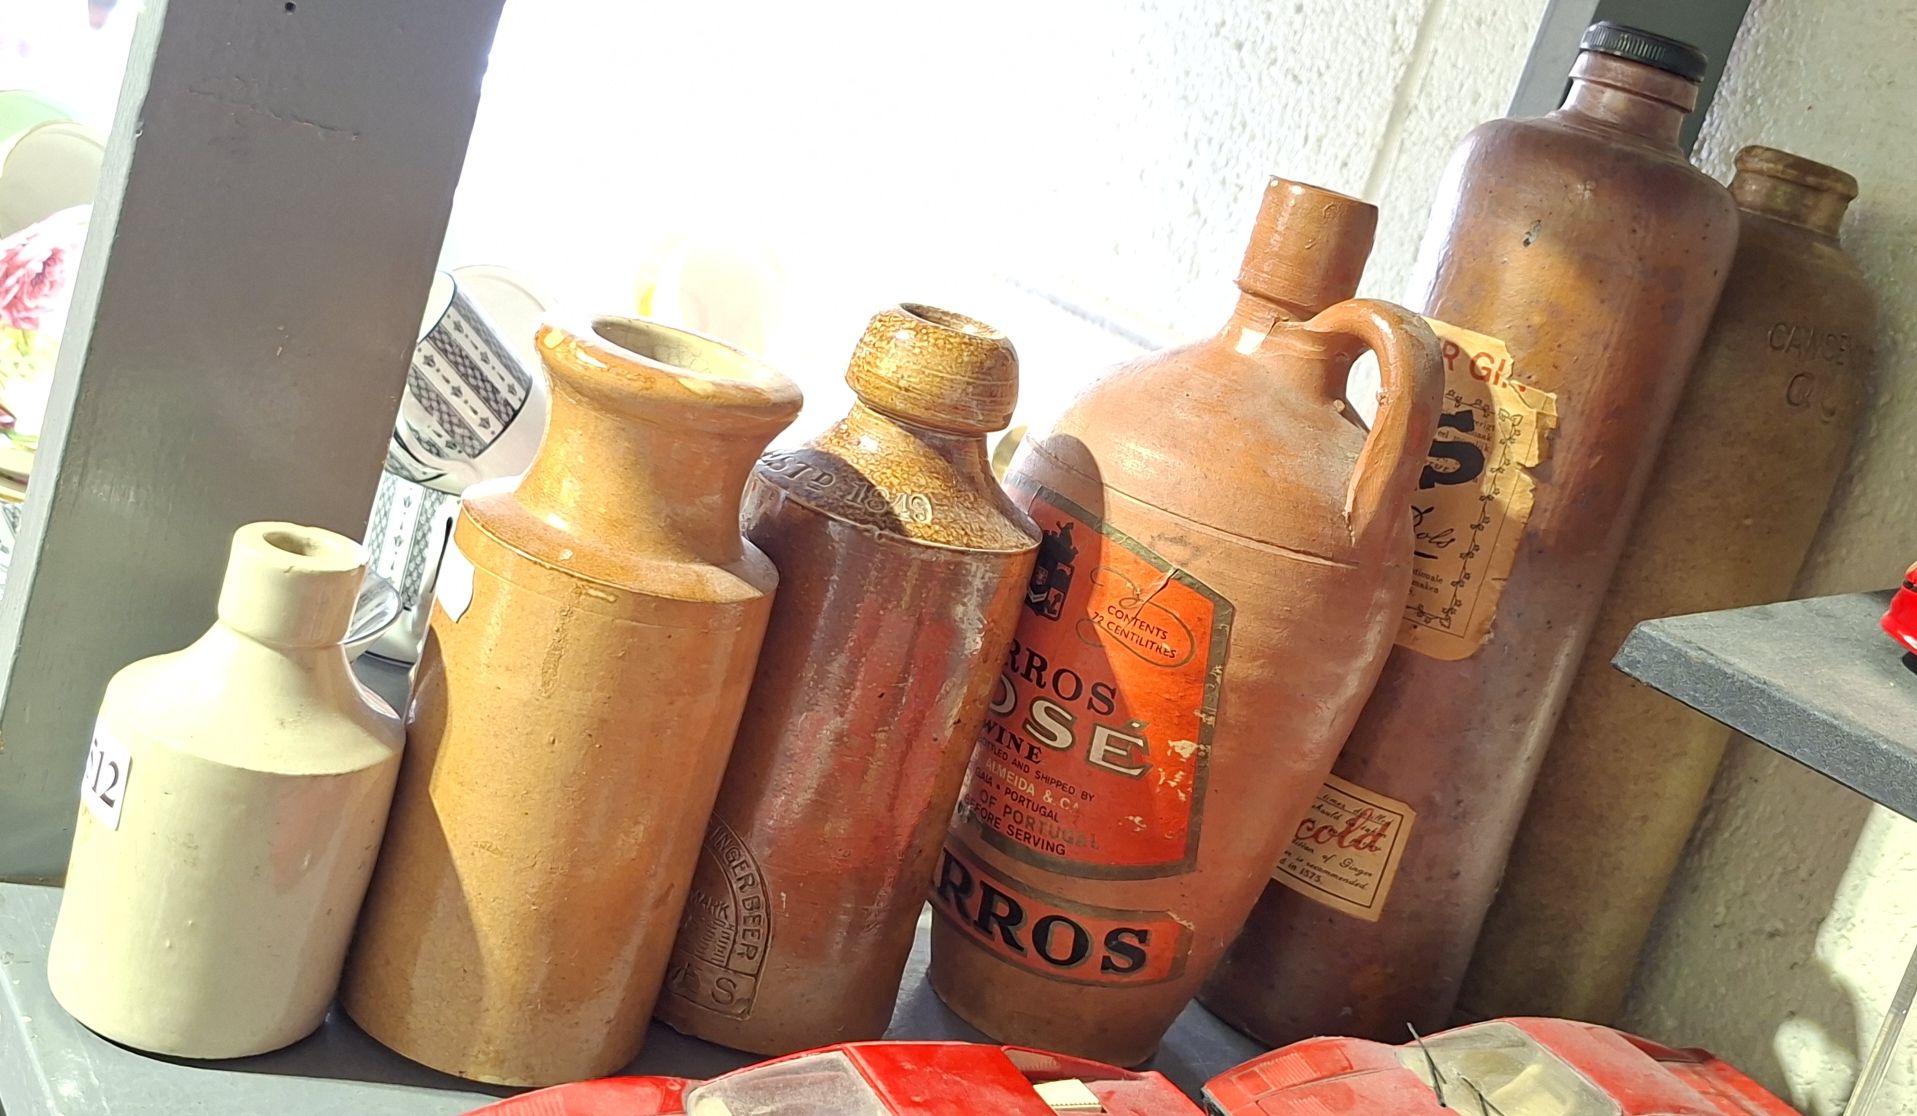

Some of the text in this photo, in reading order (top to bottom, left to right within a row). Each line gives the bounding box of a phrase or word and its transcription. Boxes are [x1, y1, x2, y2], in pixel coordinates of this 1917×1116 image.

[1092, 606, 1177, 659] 72 CENTILITRES
[1107, 600, 1169, 640] CONTENTS
[979, 788, 998, 808] OF
[985, 758, 1035, 797] ALMEIDA
[1042, 789, 1053, 804] &
[1011, 757, 1031, 775] AND
[1035, 770, 1076, 796] SHIPPED
[1081, 790, 1096, 802] BY
[1004, 786, 1060, 824] PORTUGAL
[1007, 824, 1066, 856] SERVING
[1294, 807, 1393, 853] cold
[1306, 861, 1369, 890] recommended
[736, 895, 762, 961] BEER
